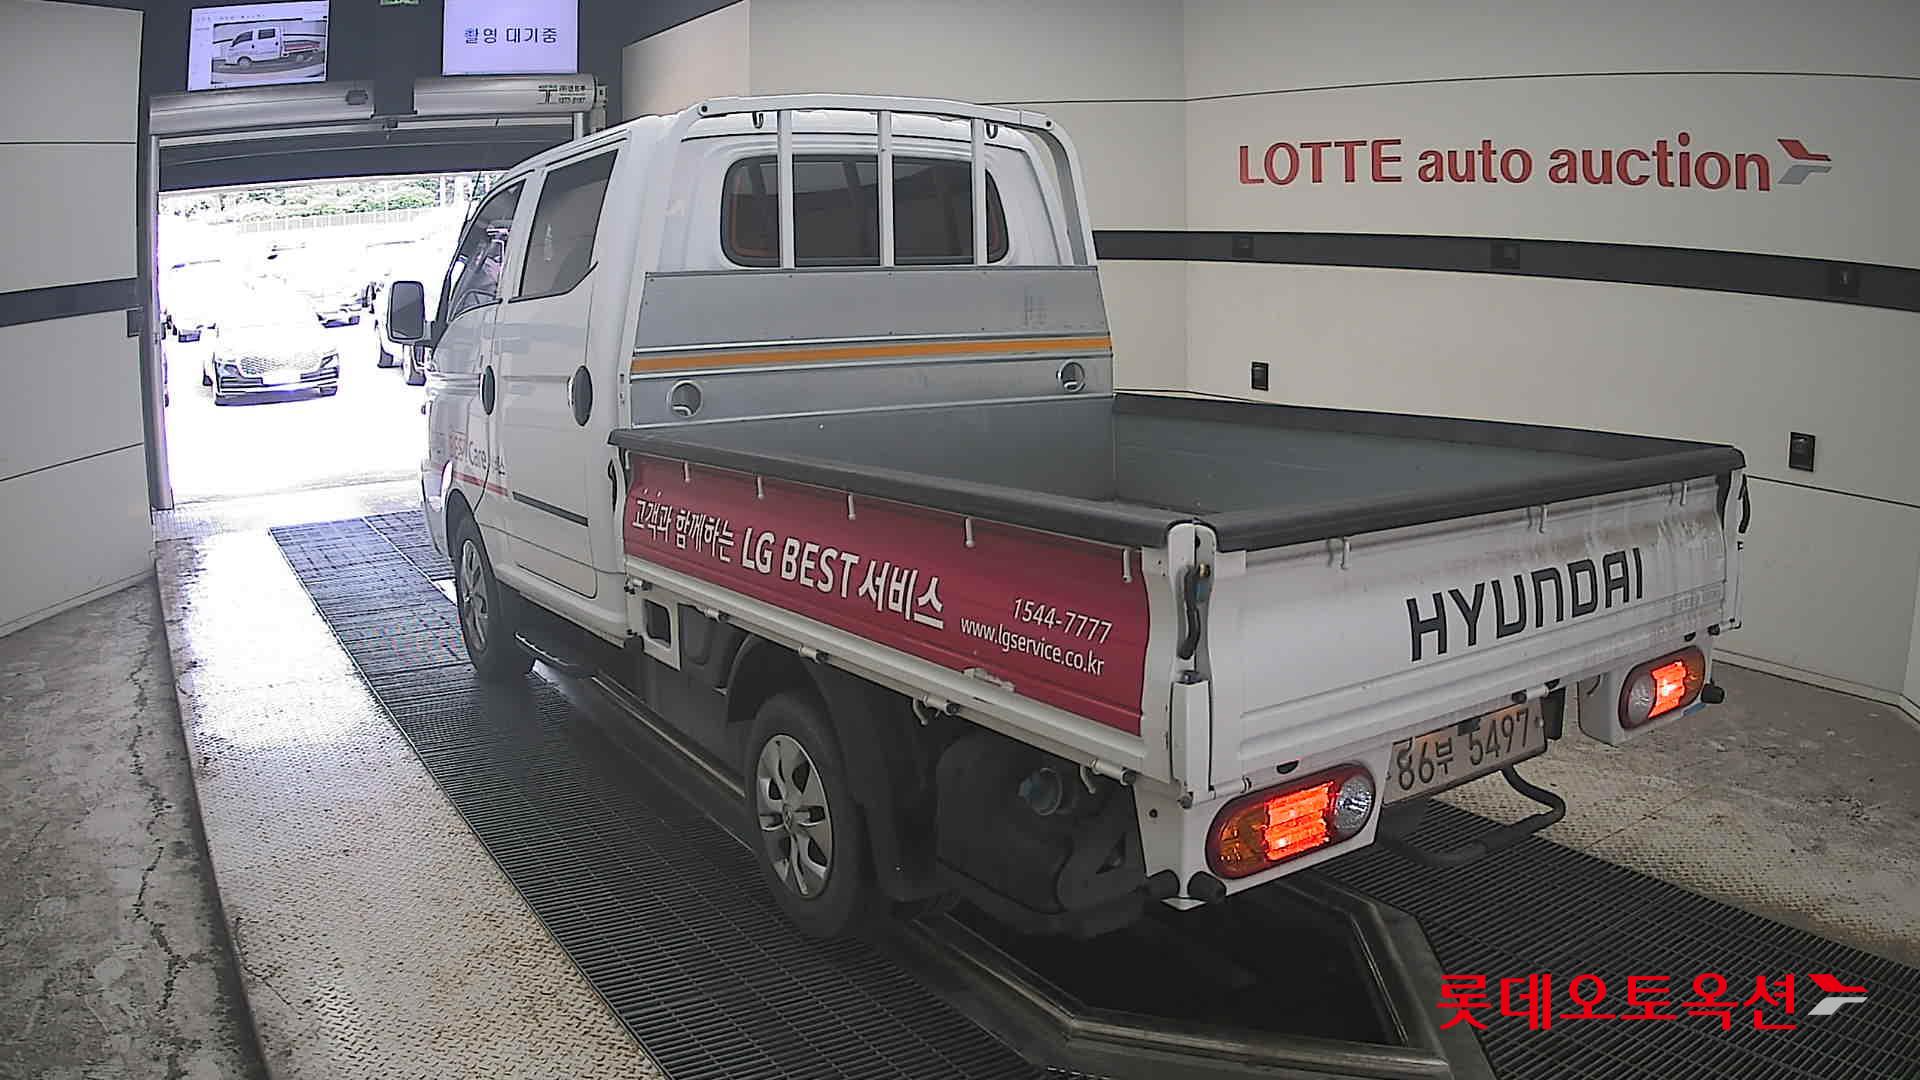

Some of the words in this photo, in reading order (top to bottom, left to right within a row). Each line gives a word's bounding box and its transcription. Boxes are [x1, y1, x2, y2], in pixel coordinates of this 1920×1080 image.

[506, 28, 557, 43] 대기중
[1239, 139, 1402, 185] LOTTE
[1418, 139, 1532, 183] auto
[1549, 131, 1771, 191] auction
[632, 496, 672, 543] 고객과
[674, 509, 734, 563] 함께하는
[741, 527, 776, 574] LG
[781, 537, 860, 599] BEST
[858, 559, 944, 630] 서비스
[1013, 598, 1112, 645] 1544-7777
[1406, 547, 1644, 662] HYUNDAI
[960, 617, 1104, 677] www.lgservice.co.kr
[1468, 707, 1529, 766] 5497
